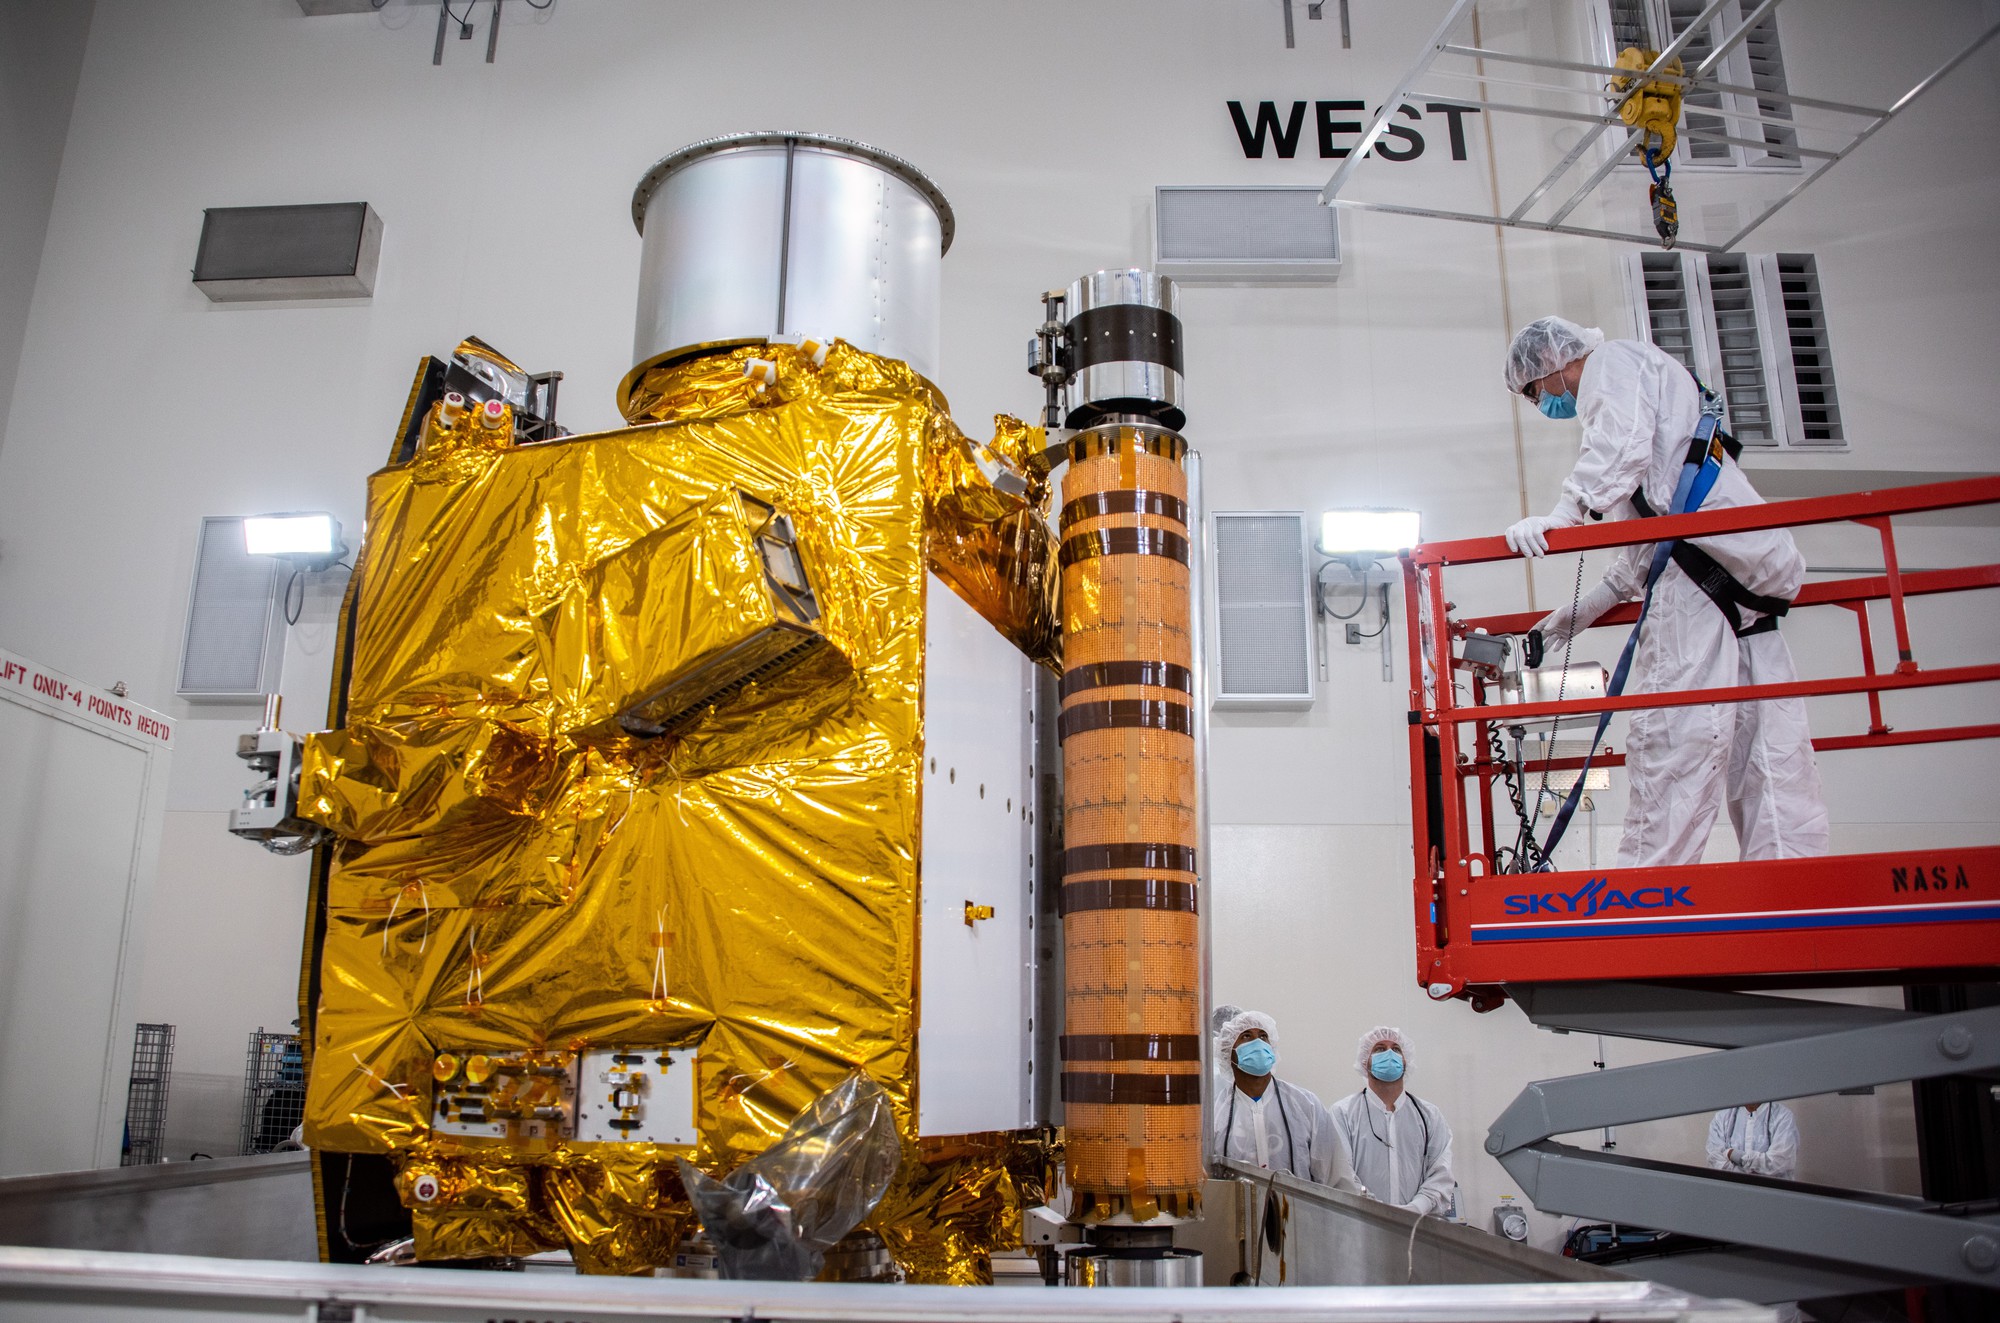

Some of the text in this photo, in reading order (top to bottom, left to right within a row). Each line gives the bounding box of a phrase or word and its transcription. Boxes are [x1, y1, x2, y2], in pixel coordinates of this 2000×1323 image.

[1226, 100, 1481, 162] WEST
[88, 694, 132, 726] POINTS
[137, 714, 170, 741] REQ'D
[1503, 877, 1696, 917] SKYJACK
[1891, 864, 1969, 893] NASA
